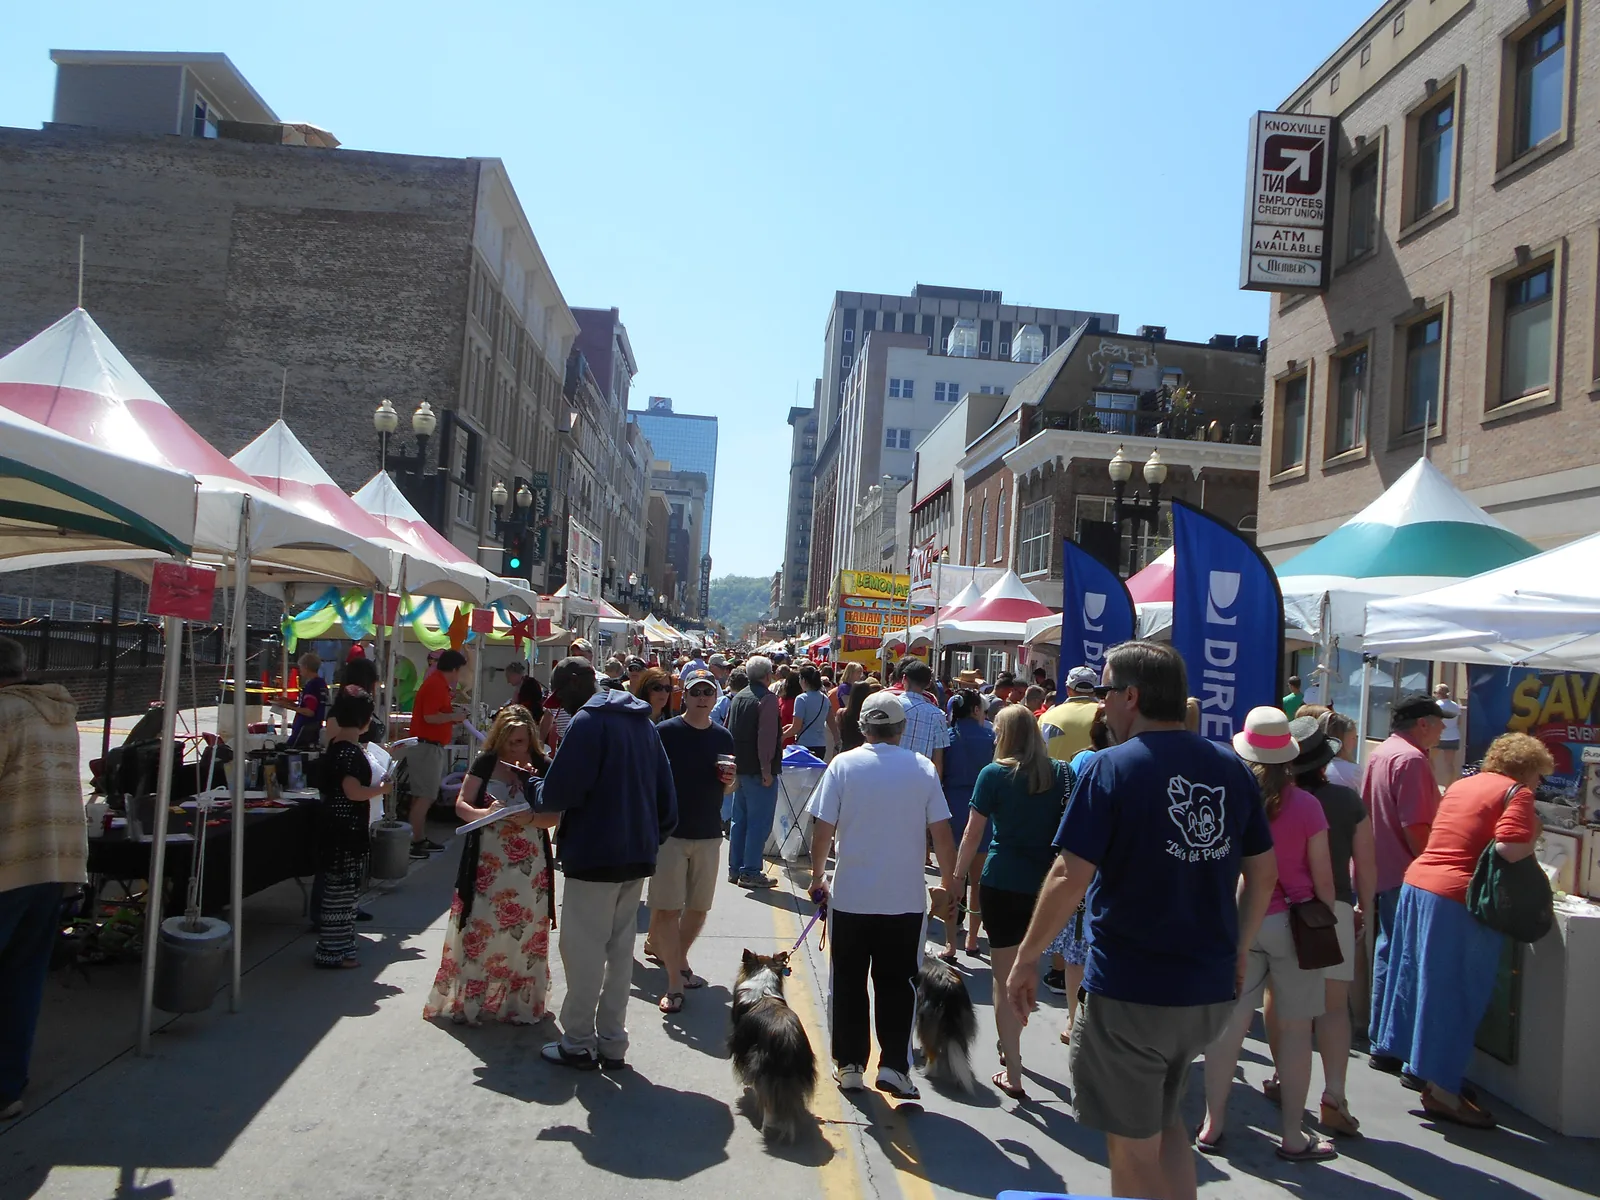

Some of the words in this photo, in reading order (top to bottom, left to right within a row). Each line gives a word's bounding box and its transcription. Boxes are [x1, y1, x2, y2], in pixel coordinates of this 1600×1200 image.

[1264, 120, 1326, 135] KNOXVILLE
[1262, 173, 1284, 193] TVA
[1258, 194, 1323, 209] EMPLOYEES
[1257, 205, 1292, 216] CREDIT
[1294, 208, 1324, 220] UNION
[1272, 229, 1305, 242] ATM
[1255, 240, 1322, 253] AVAILABLE
[700, 560, 709, 616] TENNESSEE
[845, 610, 882, 625] ITALIAN
[845, 623, 878, 638] POLISH
[1188, 850, 1200, 863] Get
